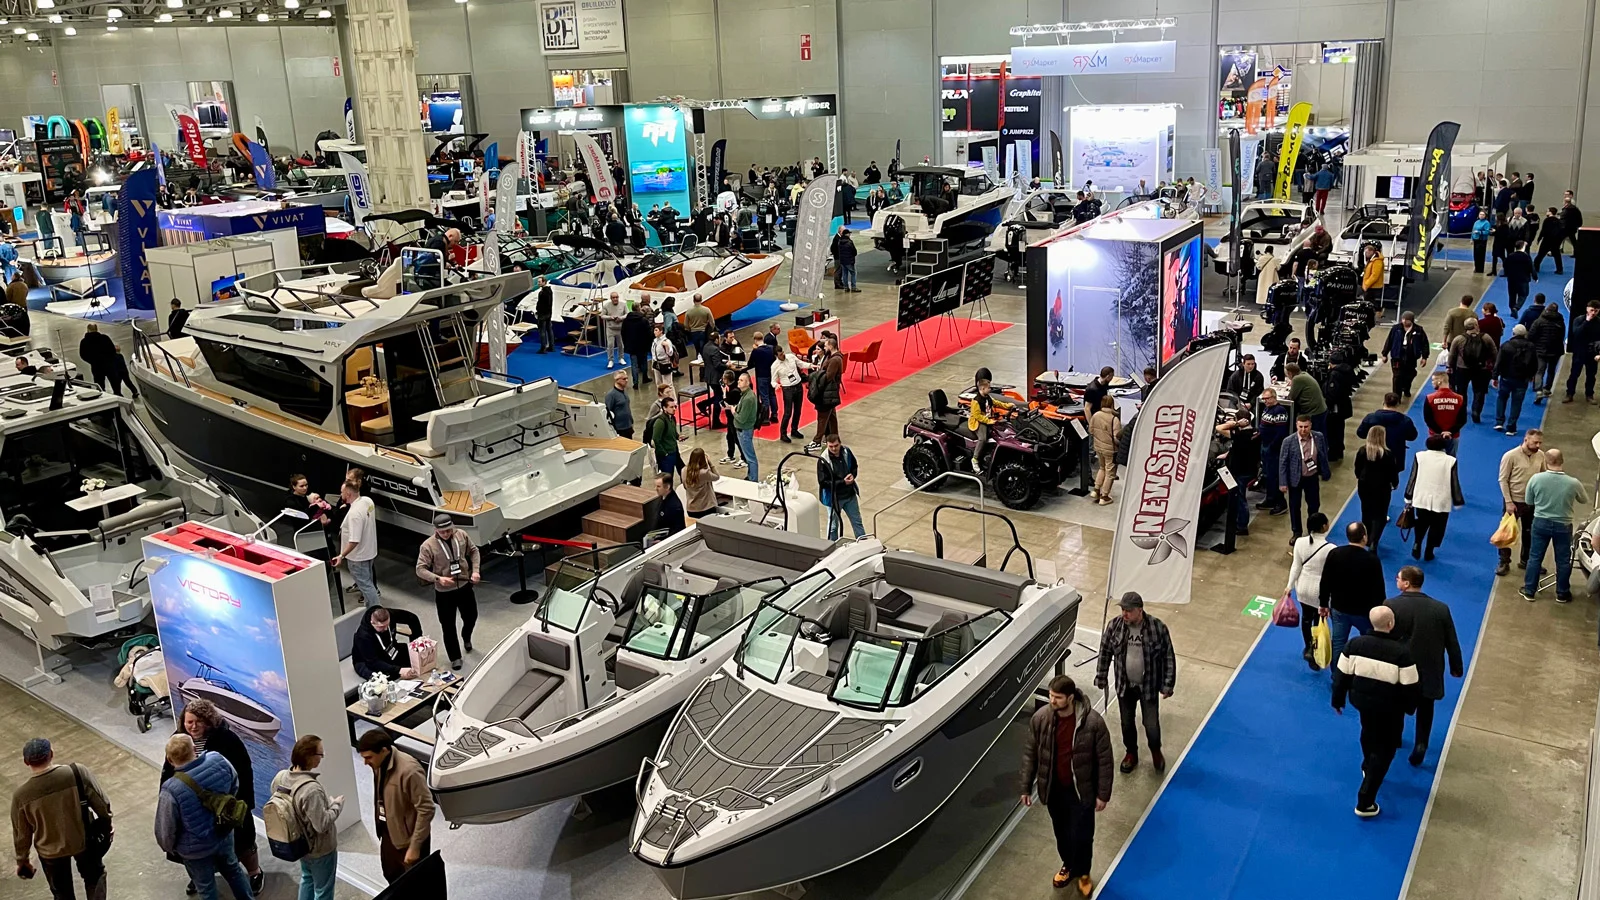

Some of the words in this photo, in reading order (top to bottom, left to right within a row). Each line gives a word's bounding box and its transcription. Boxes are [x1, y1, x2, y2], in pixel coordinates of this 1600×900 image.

[272, 213, 305, 225] VIVAT
[801, 214, 816, 286] SLIDER
[1133, 404, 1185, 534] NEWSTAR
[1175, 408, 1197, 483] marine
[176, 576, 242, 609] VICTORY
[1016, 624, 1061, 684] VICTORY
